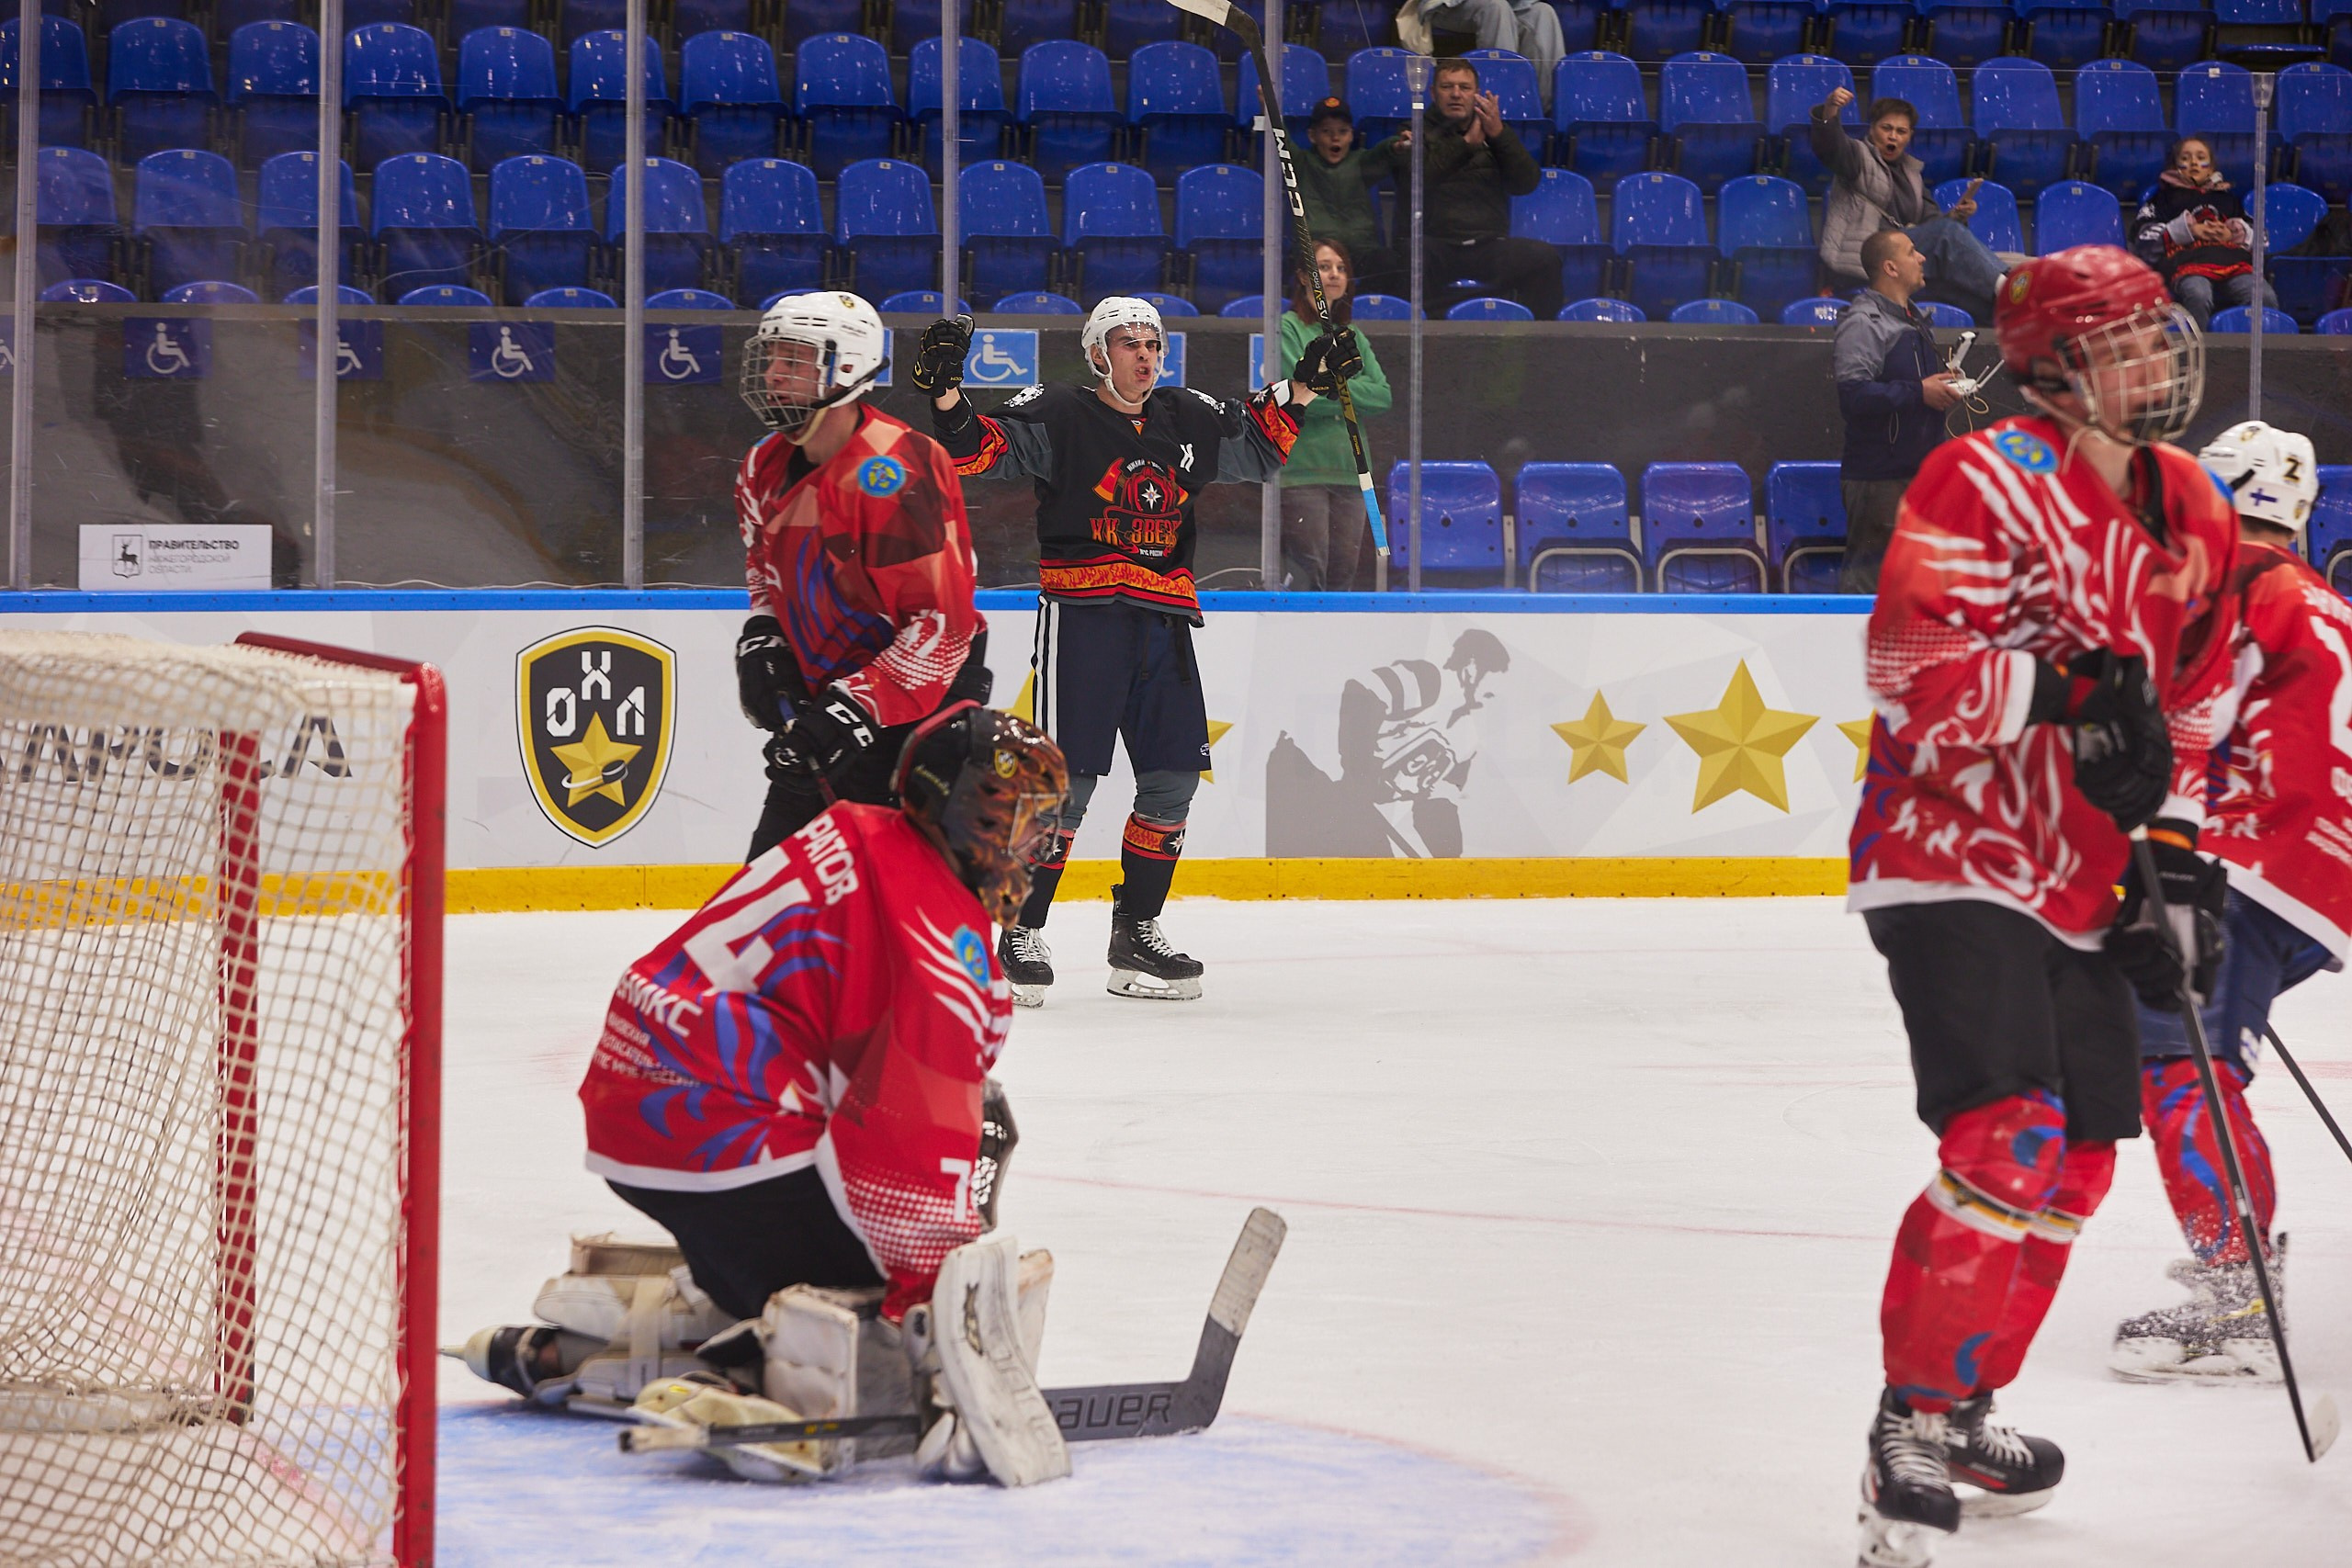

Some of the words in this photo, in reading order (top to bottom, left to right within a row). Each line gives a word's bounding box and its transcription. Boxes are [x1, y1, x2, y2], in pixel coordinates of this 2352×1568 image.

[1272, 128, 1305, 217] CCM
[2284, 457, 2301, 483] 2
[149, 540, 240, 550] ПРАВИТЕЛЬСТВО
[1090, 518, 1120, 546] ХК
[547, 650, 645, 738] ОХЛ
[794, 813, 859, 905] РАТОВ
[1049, 1393, 1172, 1429] AUER
